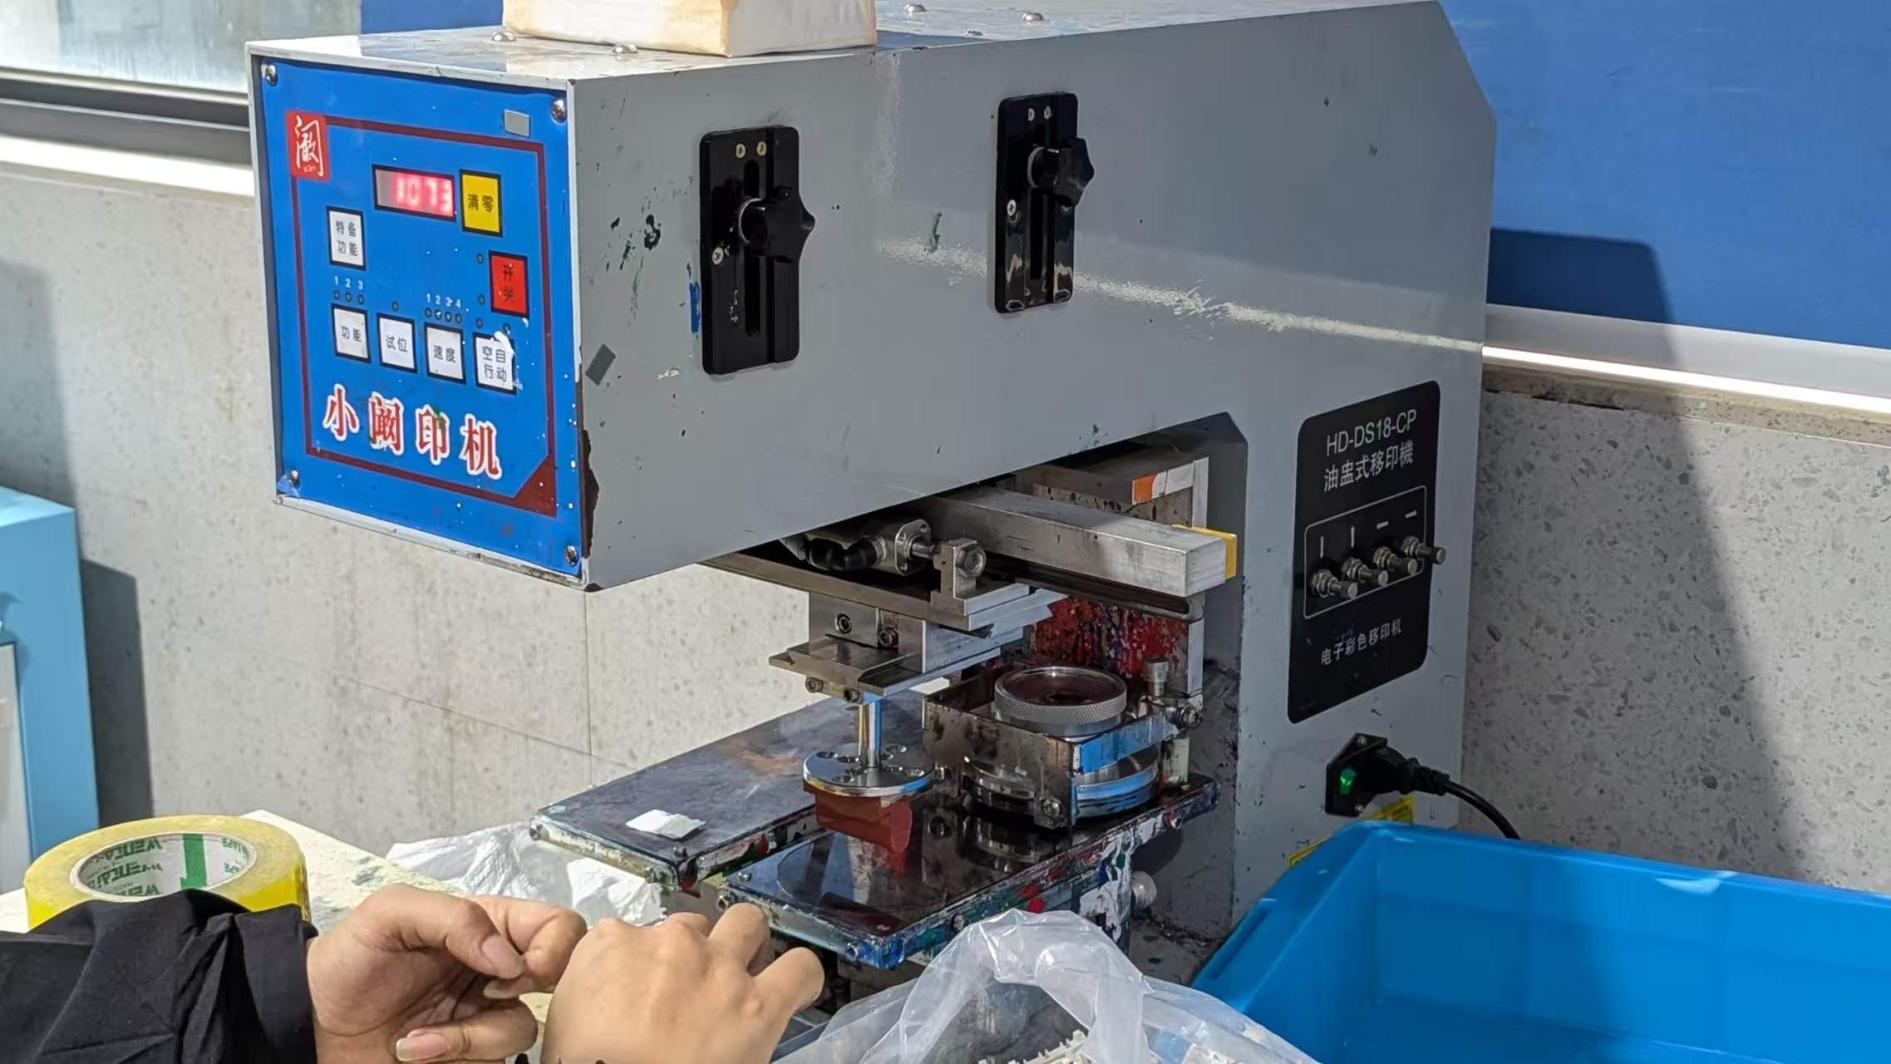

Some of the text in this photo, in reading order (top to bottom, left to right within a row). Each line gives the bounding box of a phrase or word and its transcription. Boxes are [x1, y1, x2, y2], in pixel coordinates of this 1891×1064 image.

[467, 193, 495, 213] 清零
[336, 240, 359, 256] 功能
[501, 263, 515, 305] 开关
[340, 325, 362, 343] 功能
[385, 335, 409, 353] 试位
[433, 345, 456, 363] 速度
[1326, 408, 1417, 457] HD-DS18-CP
[1320, 618, 1402, 666] 电子彩色移印机
